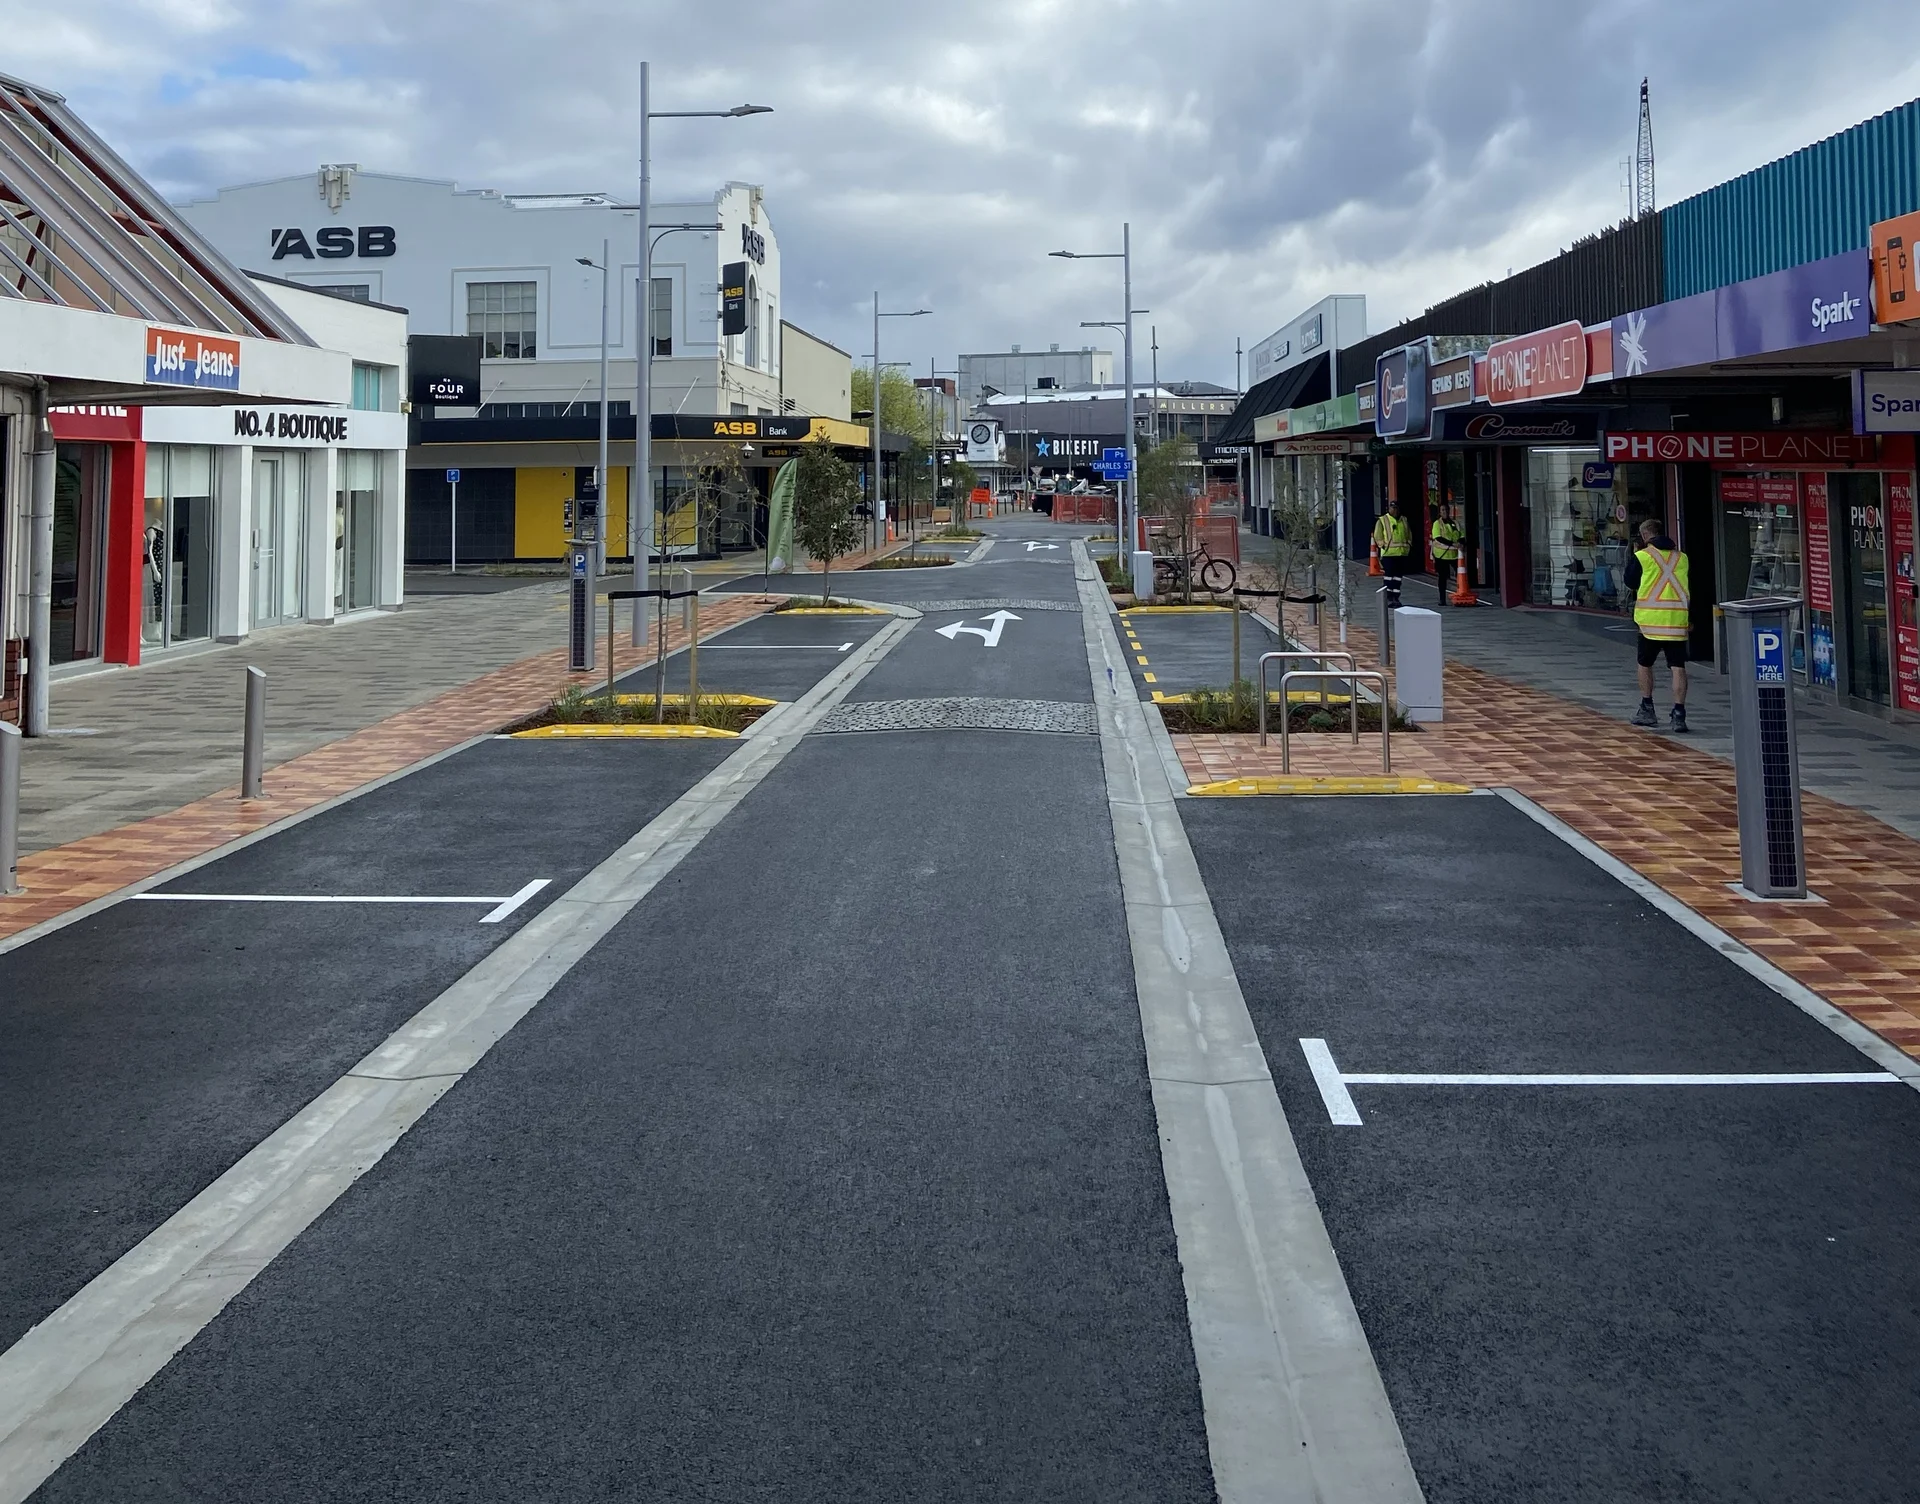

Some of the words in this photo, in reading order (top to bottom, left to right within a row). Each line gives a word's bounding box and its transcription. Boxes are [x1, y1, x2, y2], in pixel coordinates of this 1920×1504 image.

[271, 226, 396, 260] ASB
[742, 223, 765, 266] ASB
[725, 287, 743, 298] ASB
[1811, 291, 1854, 333] Spark
[153, 336, 186, 376] Just
[194, 342, 234, 380] Jeans
[1454, 369, 1470, 390] KEYS
[429, 384, 464, 394] FOUR
[1160, 402, 1225, 411] MILLERS
[234, 409, 263, 437] NO.
[265, 412, 275, 437] 4
[278, 413, 348, 443] BOUTIQUE
[713, 421, 757, 435] ASB
[769, 426, 788, 436] Bank
[1052, 439, 1099, 456] BIKEFIT
[1092, 462, 1121, 470] CHARLES
[1123, 462, 1131, 470] ST
[575, 554, 585, 567] P
[1757, 633, 1780, 660] P
[1758, 672, 1783, 681] HERE
[1761, 664, 1778, 673] PAY
